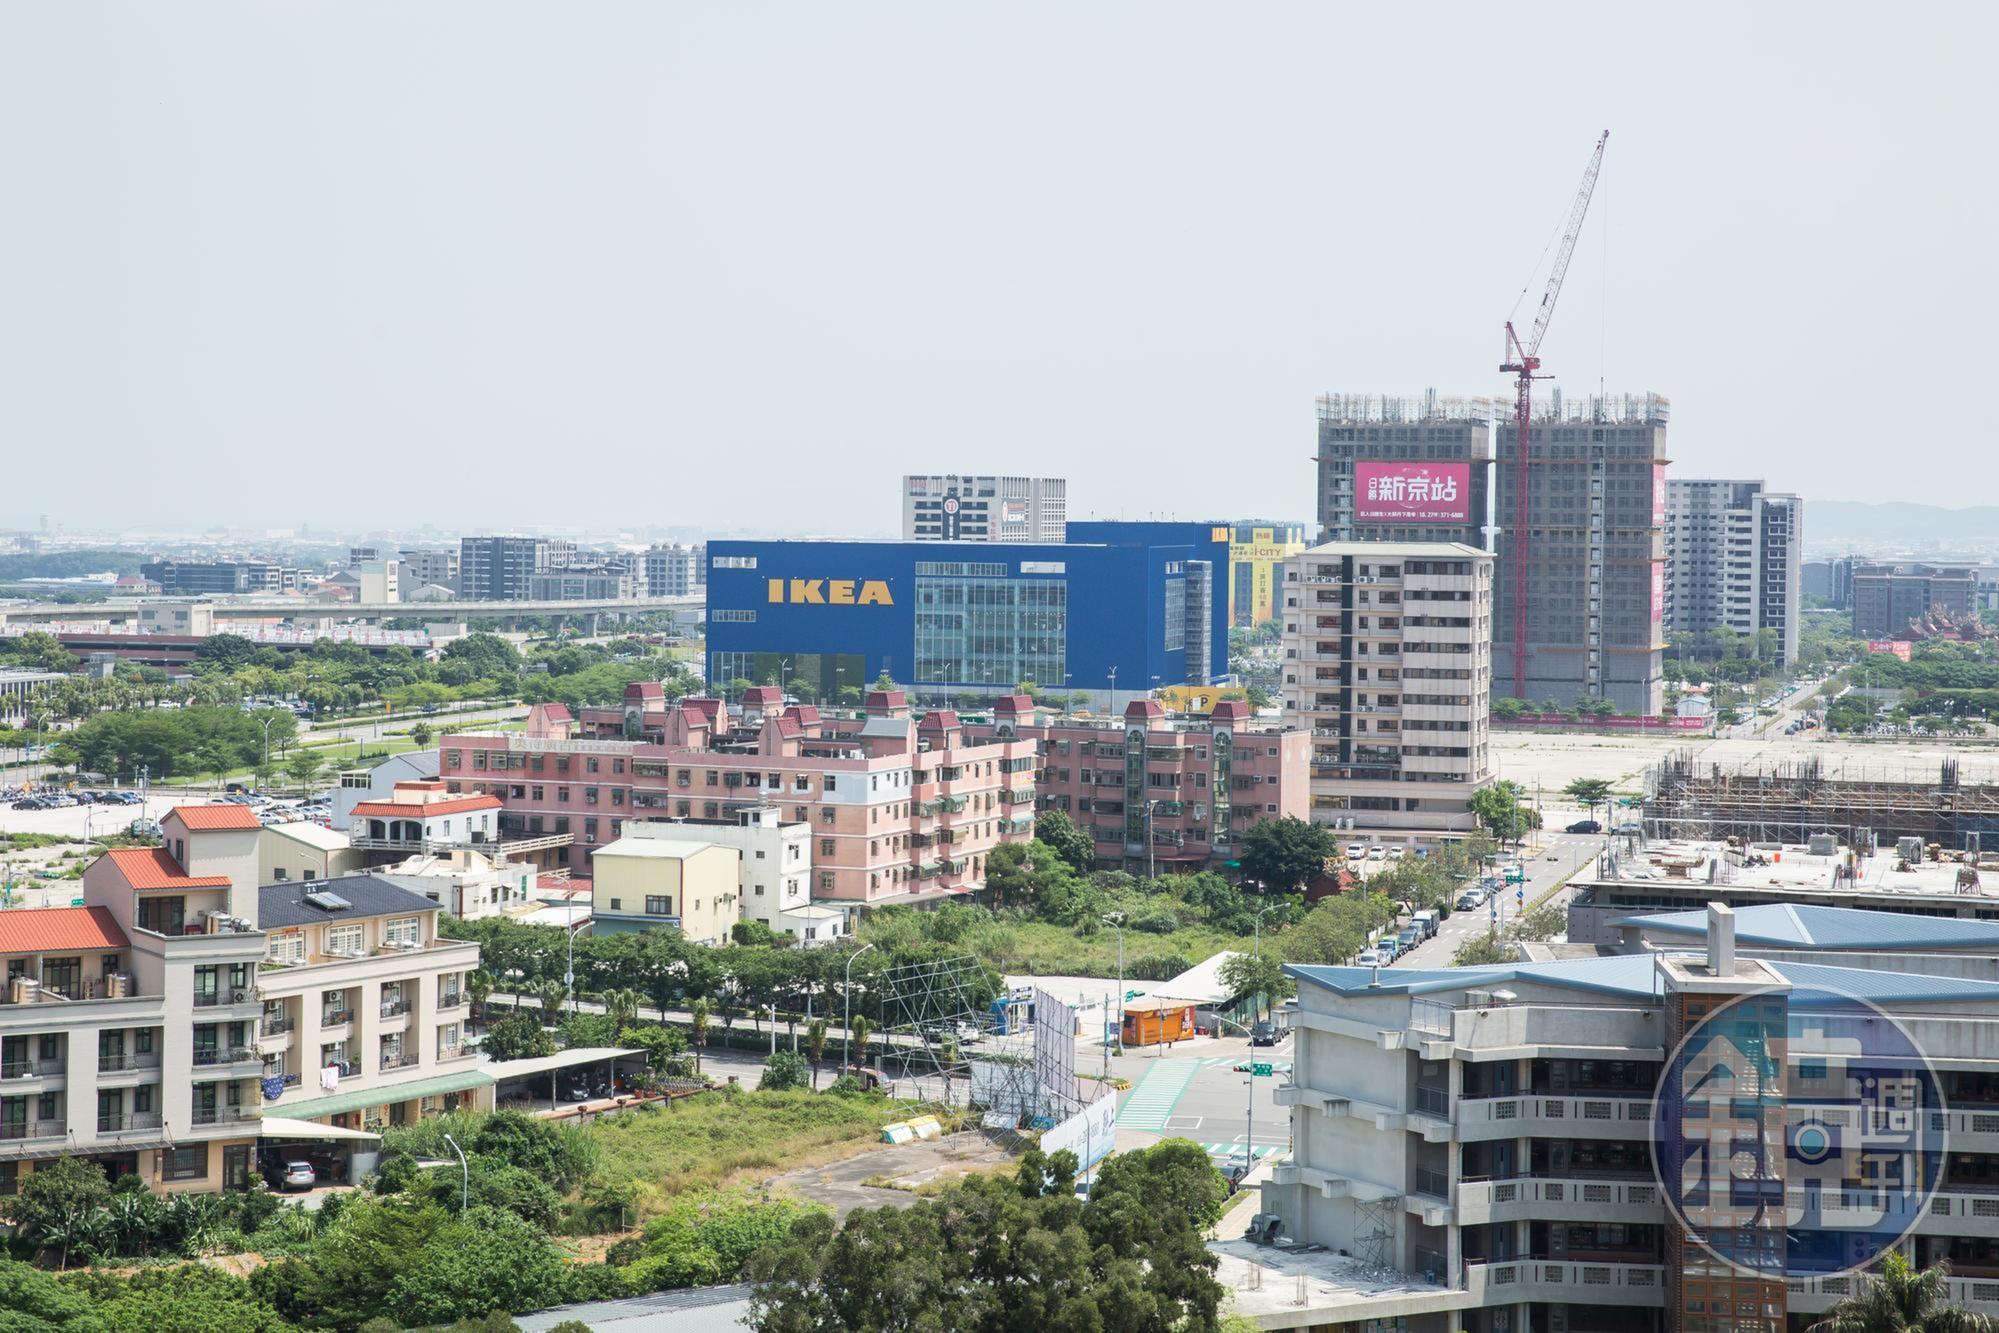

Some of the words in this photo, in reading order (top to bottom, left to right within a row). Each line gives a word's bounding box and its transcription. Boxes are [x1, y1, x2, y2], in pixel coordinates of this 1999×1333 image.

[1379, 475, 1457, 502] 新京站
[768, 578, 894, 605] IKEA
